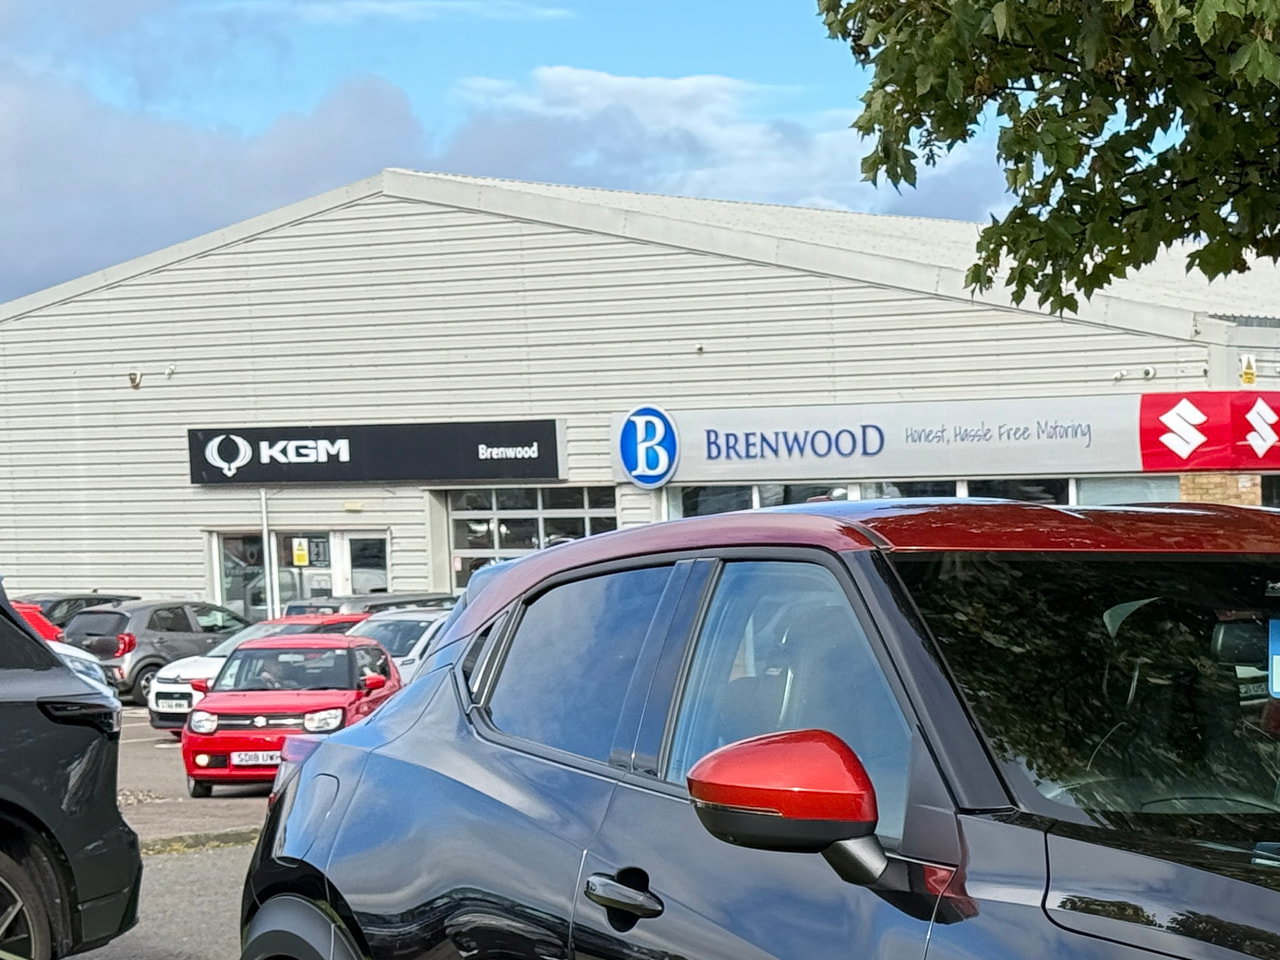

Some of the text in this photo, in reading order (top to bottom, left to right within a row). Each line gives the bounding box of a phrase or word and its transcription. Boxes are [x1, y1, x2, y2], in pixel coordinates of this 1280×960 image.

[629, 415, 885, 476] B BRENWOOD
[905, 419, 1092, 448] Honest, Hassle Free Motoring
[259, 439, 351, 464] KGM
[478, 442, 539, 460] Brenwood
